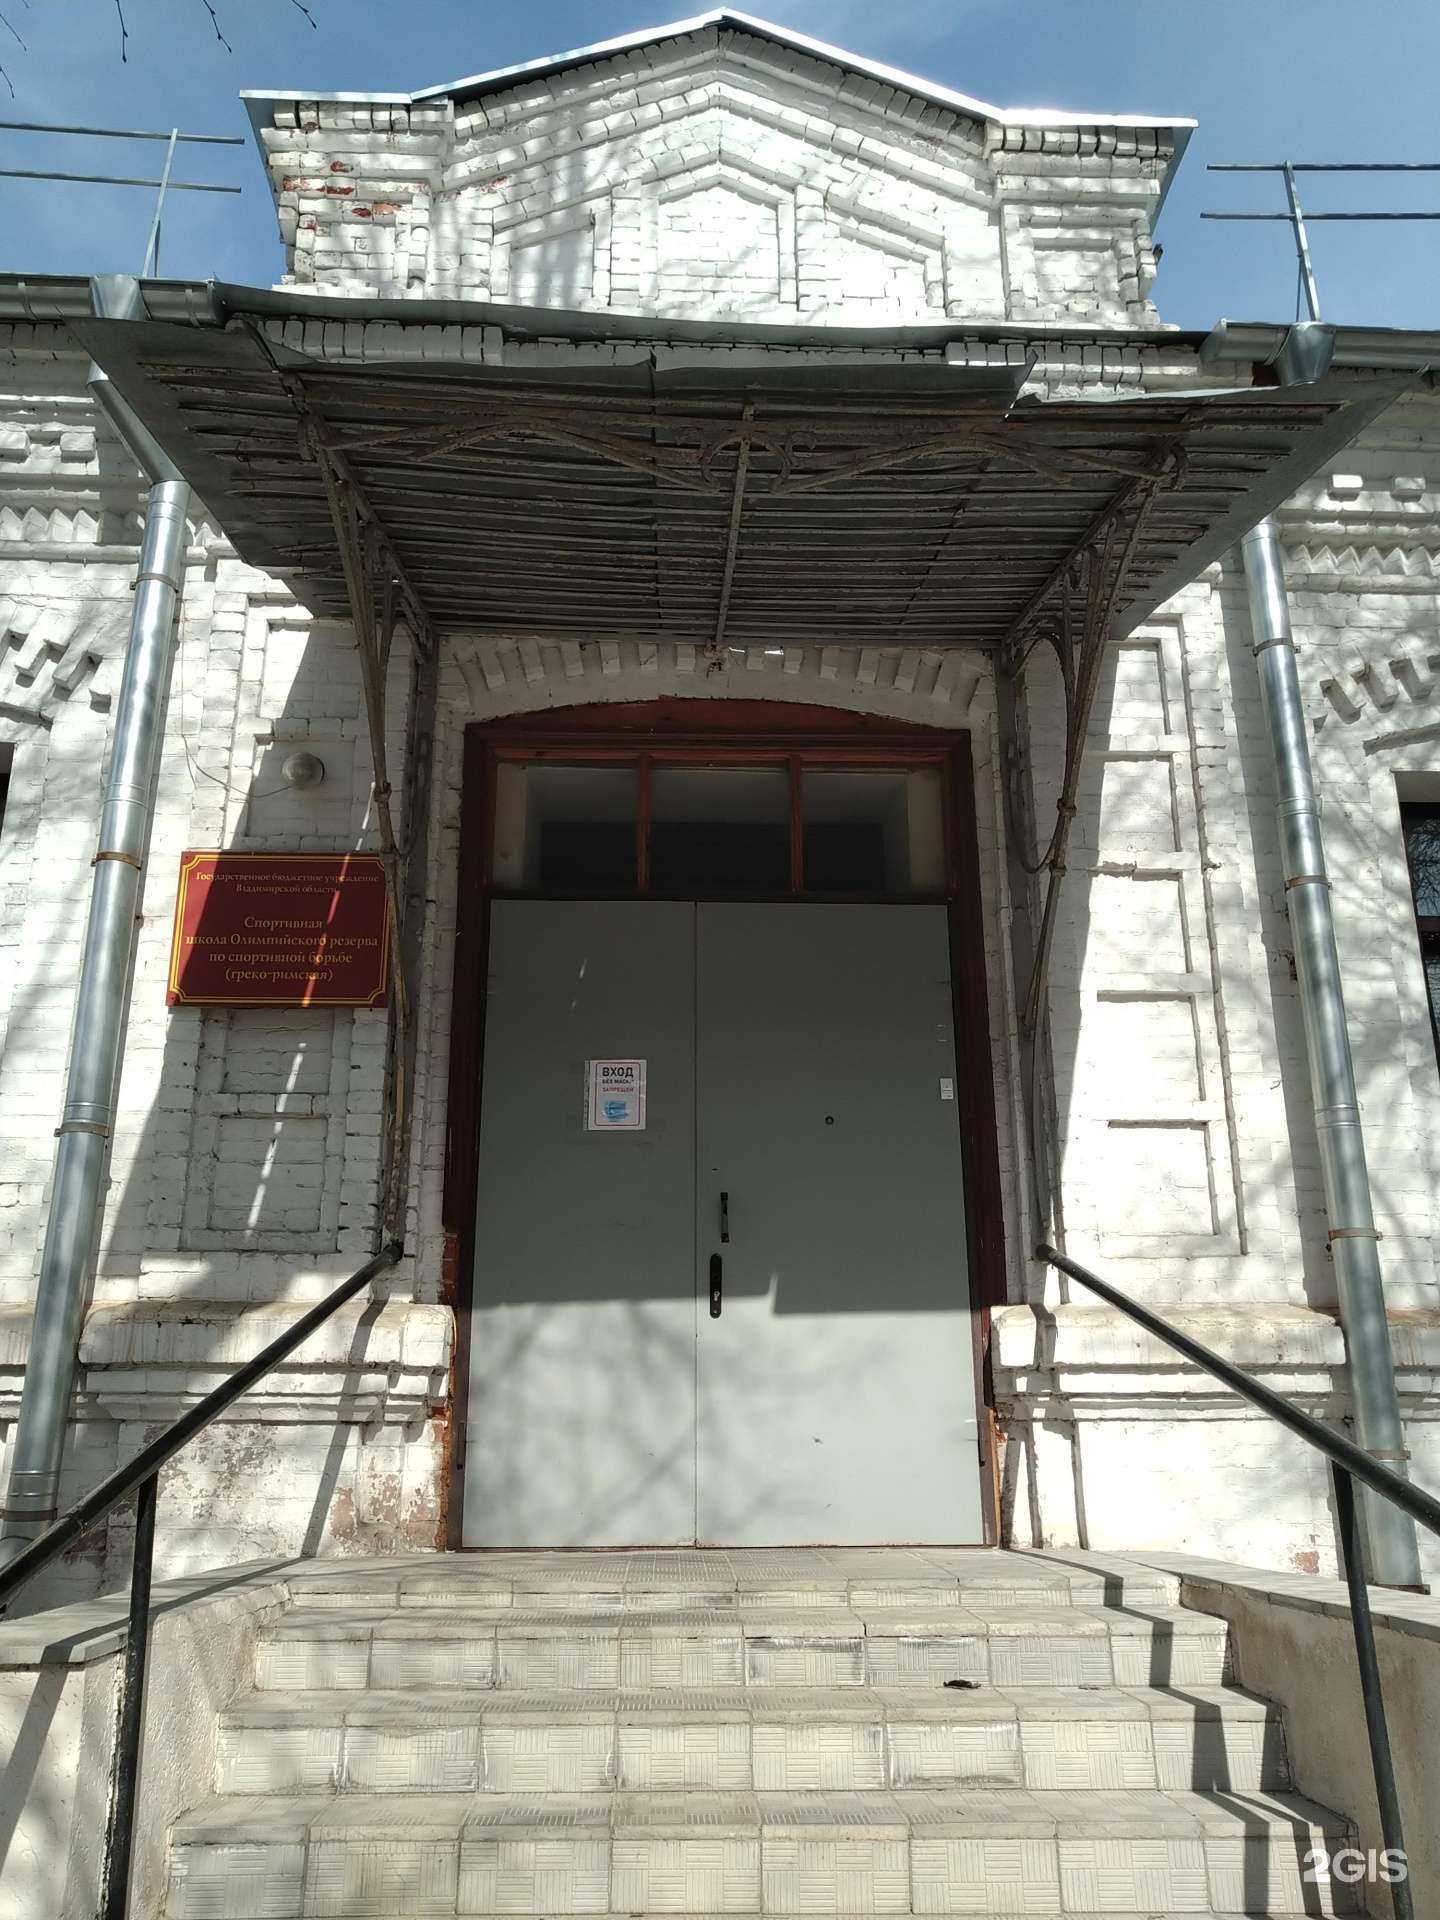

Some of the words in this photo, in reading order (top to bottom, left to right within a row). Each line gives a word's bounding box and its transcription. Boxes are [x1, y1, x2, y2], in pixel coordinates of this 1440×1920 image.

[196, 872, 271, 882] Государственное
[272, 872, 323, 882] бюджетное
[324, 874, 379, 884] учреждение
[236, 885, 301, 893] Владимирской
[303, 885, 337, 893] области
[244, 917, 322, 930] Спортивная
[186, 935, 227, 945] школа
[231, 933, 327, 948] Олимпийского
[329, 938, 378, 948] резерва
[209, 953, 225, 962] по
[228, 952, 305, 963] спортивной
[308, 952, 353, 964] борьбе
[225, 969, 333, 982] (греко-римская)
[602, 1067, 633, 1078] ВХОД
